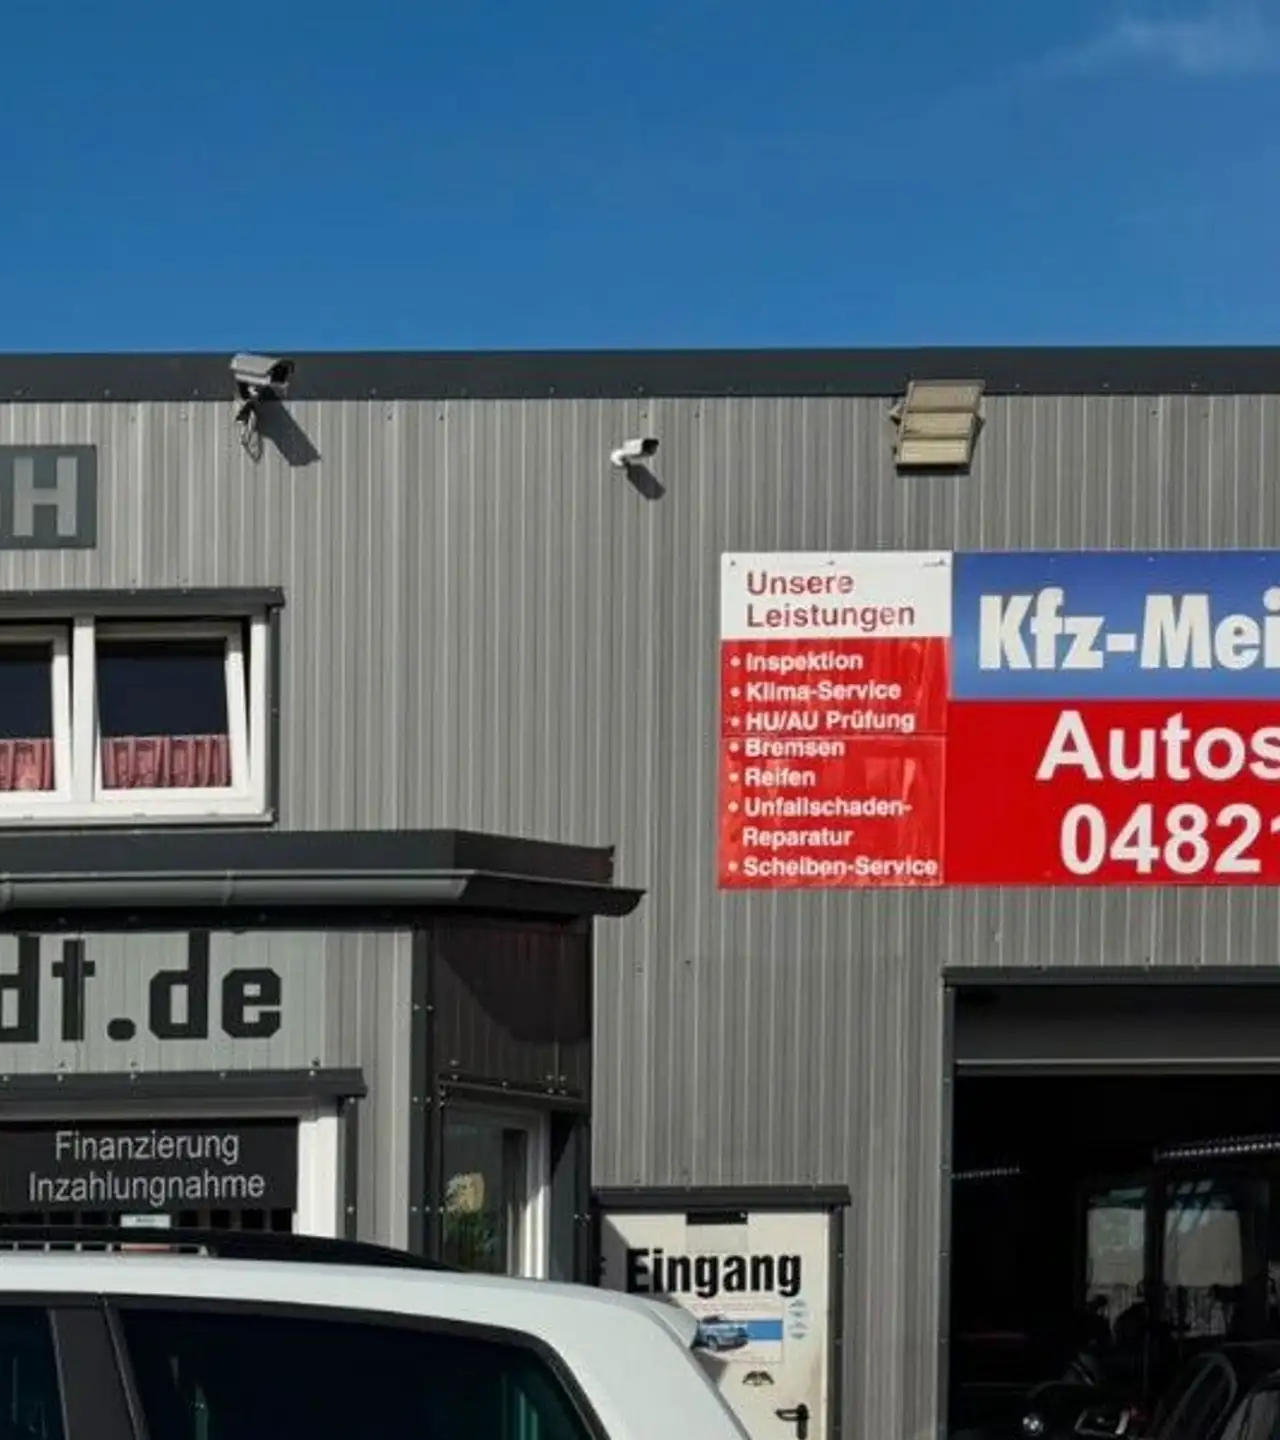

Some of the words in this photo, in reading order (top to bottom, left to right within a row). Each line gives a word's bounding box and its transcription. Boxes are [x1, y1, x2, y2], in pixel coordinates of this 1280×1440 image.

[746, 570, 855, 595] Unsere
[746, 602, 916, 633] Leistungen
[745, 651, 864, 676] Inspektion
[746, 680, 902, 702] Klima-Service
[745, 710, 819, 731] HU/AU
[826, 709, 916, 733] Prüfung
[744, 737, 846, 758] Bremsen
[744, 766, 817, 787] Reifen
[744, 796, 913, 817] Unfallschaden-
[742, 827, 855, 851] Reparatur
[742, 855, 939, 877] Scheiben-Service
[54, 1129, 241, 1166] Finanzierung
[28, 1169, 266, 1208] Inzahlungnahme
[626, 1248, 802, 1299] Eingang
